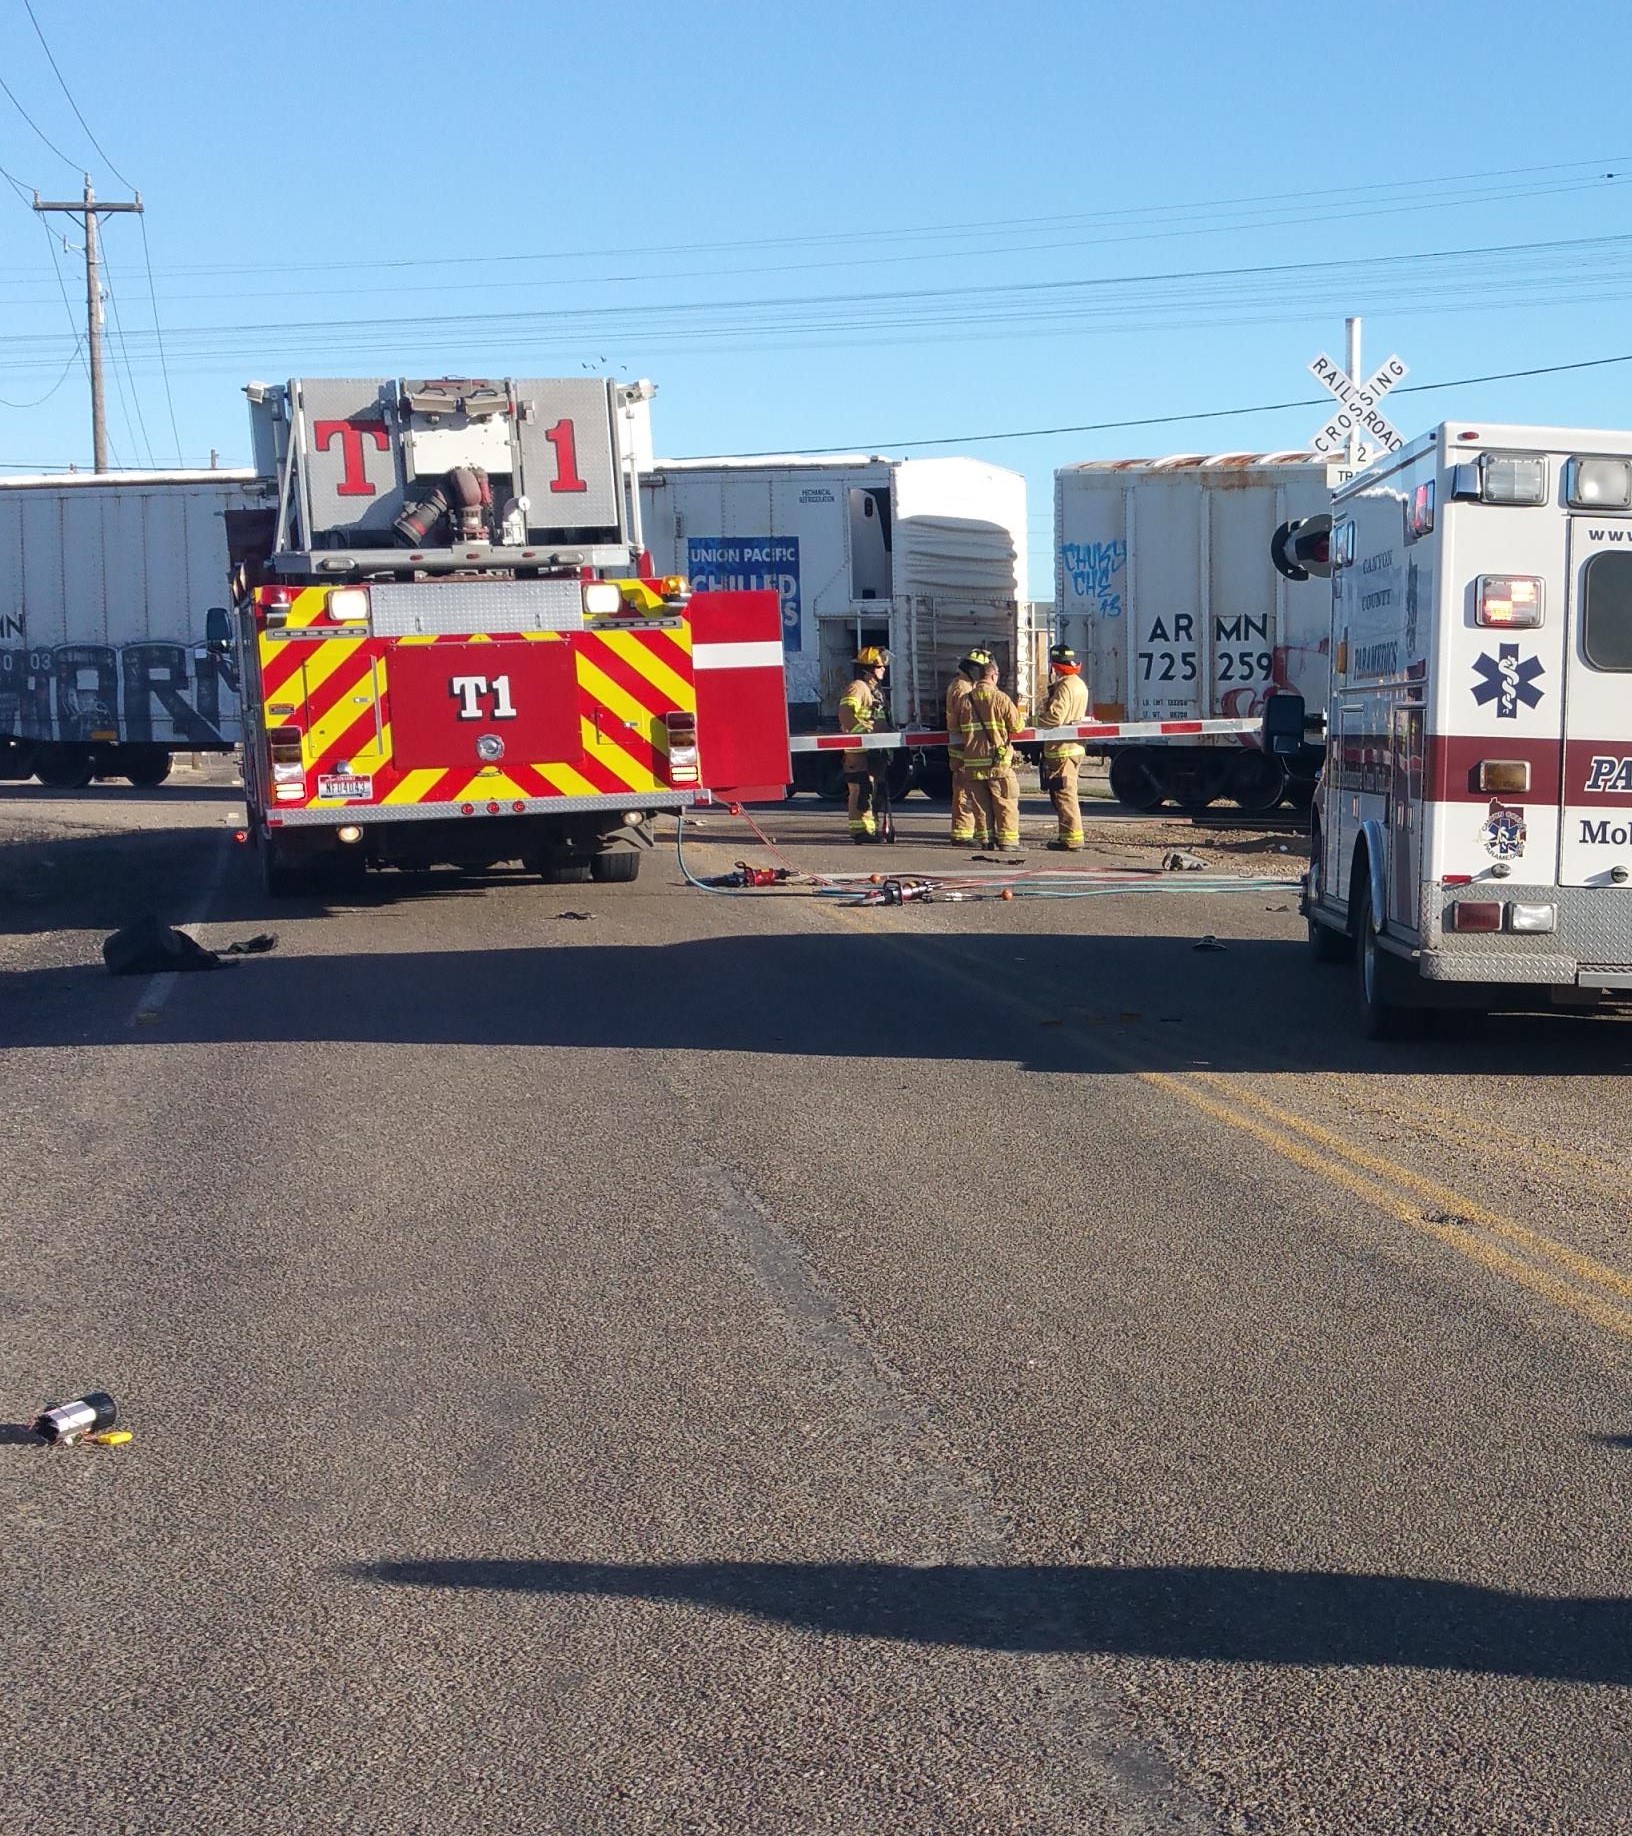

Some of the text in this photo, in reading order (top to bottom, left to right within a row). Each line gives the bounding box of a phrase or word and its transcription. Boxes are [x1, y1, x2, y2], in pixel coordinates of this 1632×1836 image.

[1314, 360, 1403, 453] CROSSING
[313, 419, 587, 496] T 1
[1357, 447, 1367, 462] 2
[691, 548, 795, 562] UNION PACIFIC
[691, 574, 797, 599] CHILLED
[1148, 613, 1268, 642] AR MN
[1138, 652, 1273, 681] 725 259
[1354, 641, 1398, 681] PARAMEDICS
[452, 675, 518, 718] T1
